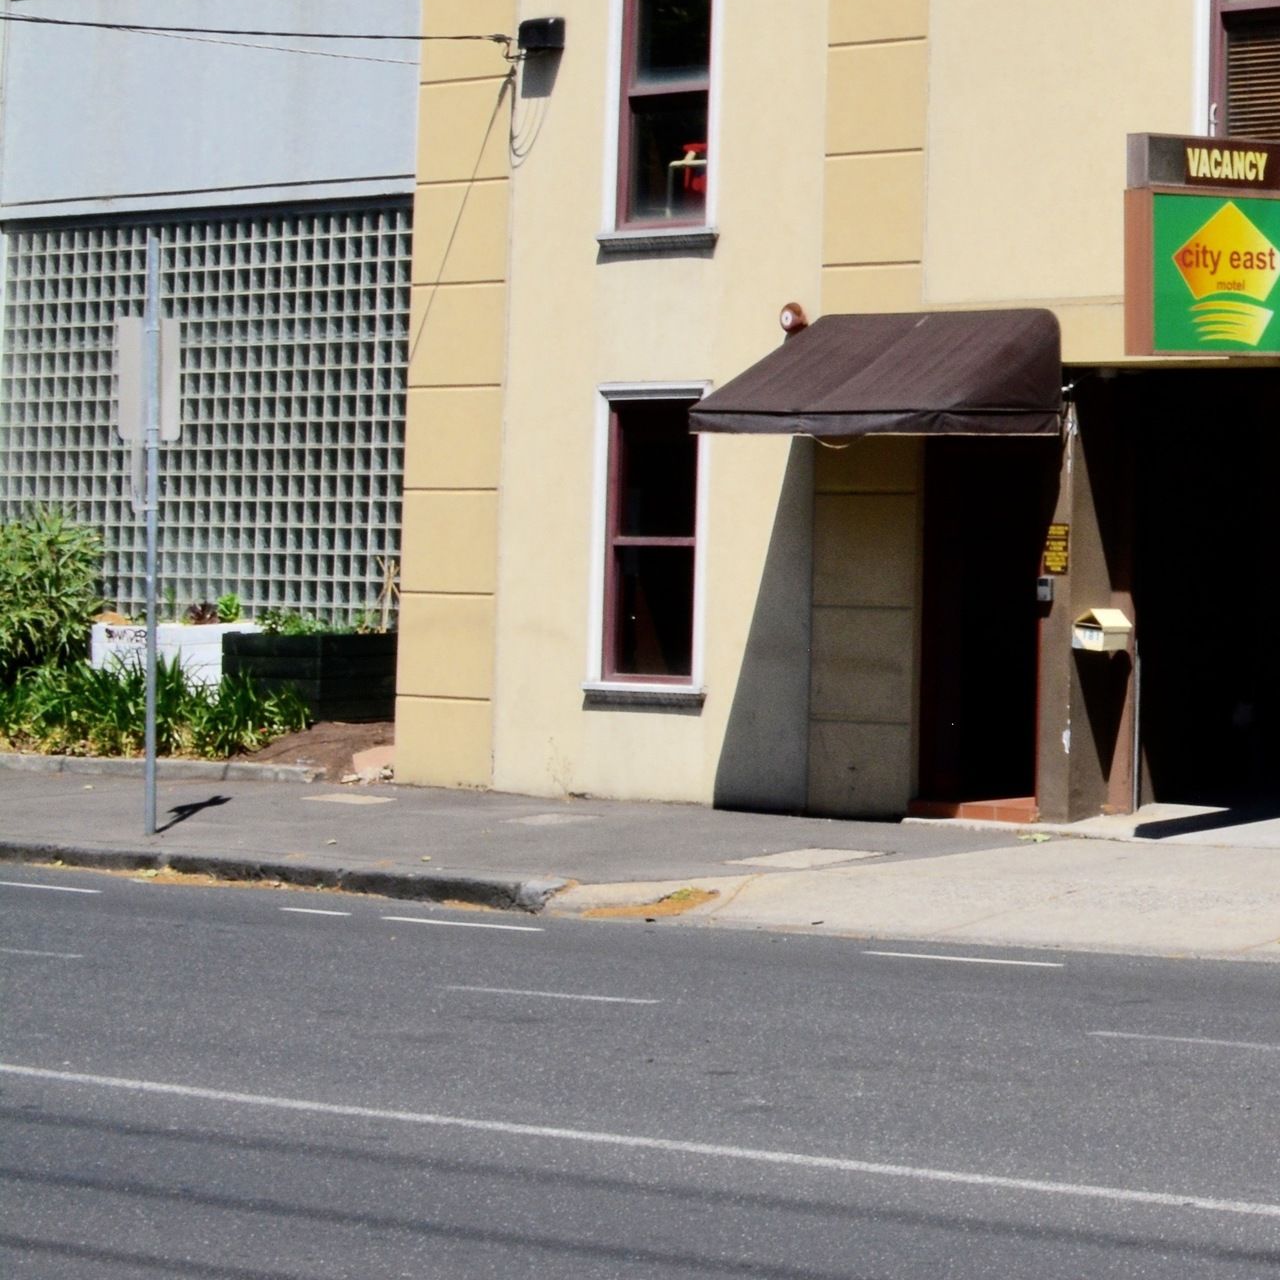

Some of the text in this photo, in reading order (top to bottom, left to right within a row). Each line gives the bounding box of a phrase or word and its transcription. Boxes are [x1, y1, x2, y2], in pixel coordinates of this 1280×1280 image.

[1187, 147, 1268, 181] VACANCY
[1181, 243, 1276, 275] city east
[1216, 278, 1245, 291] motel
